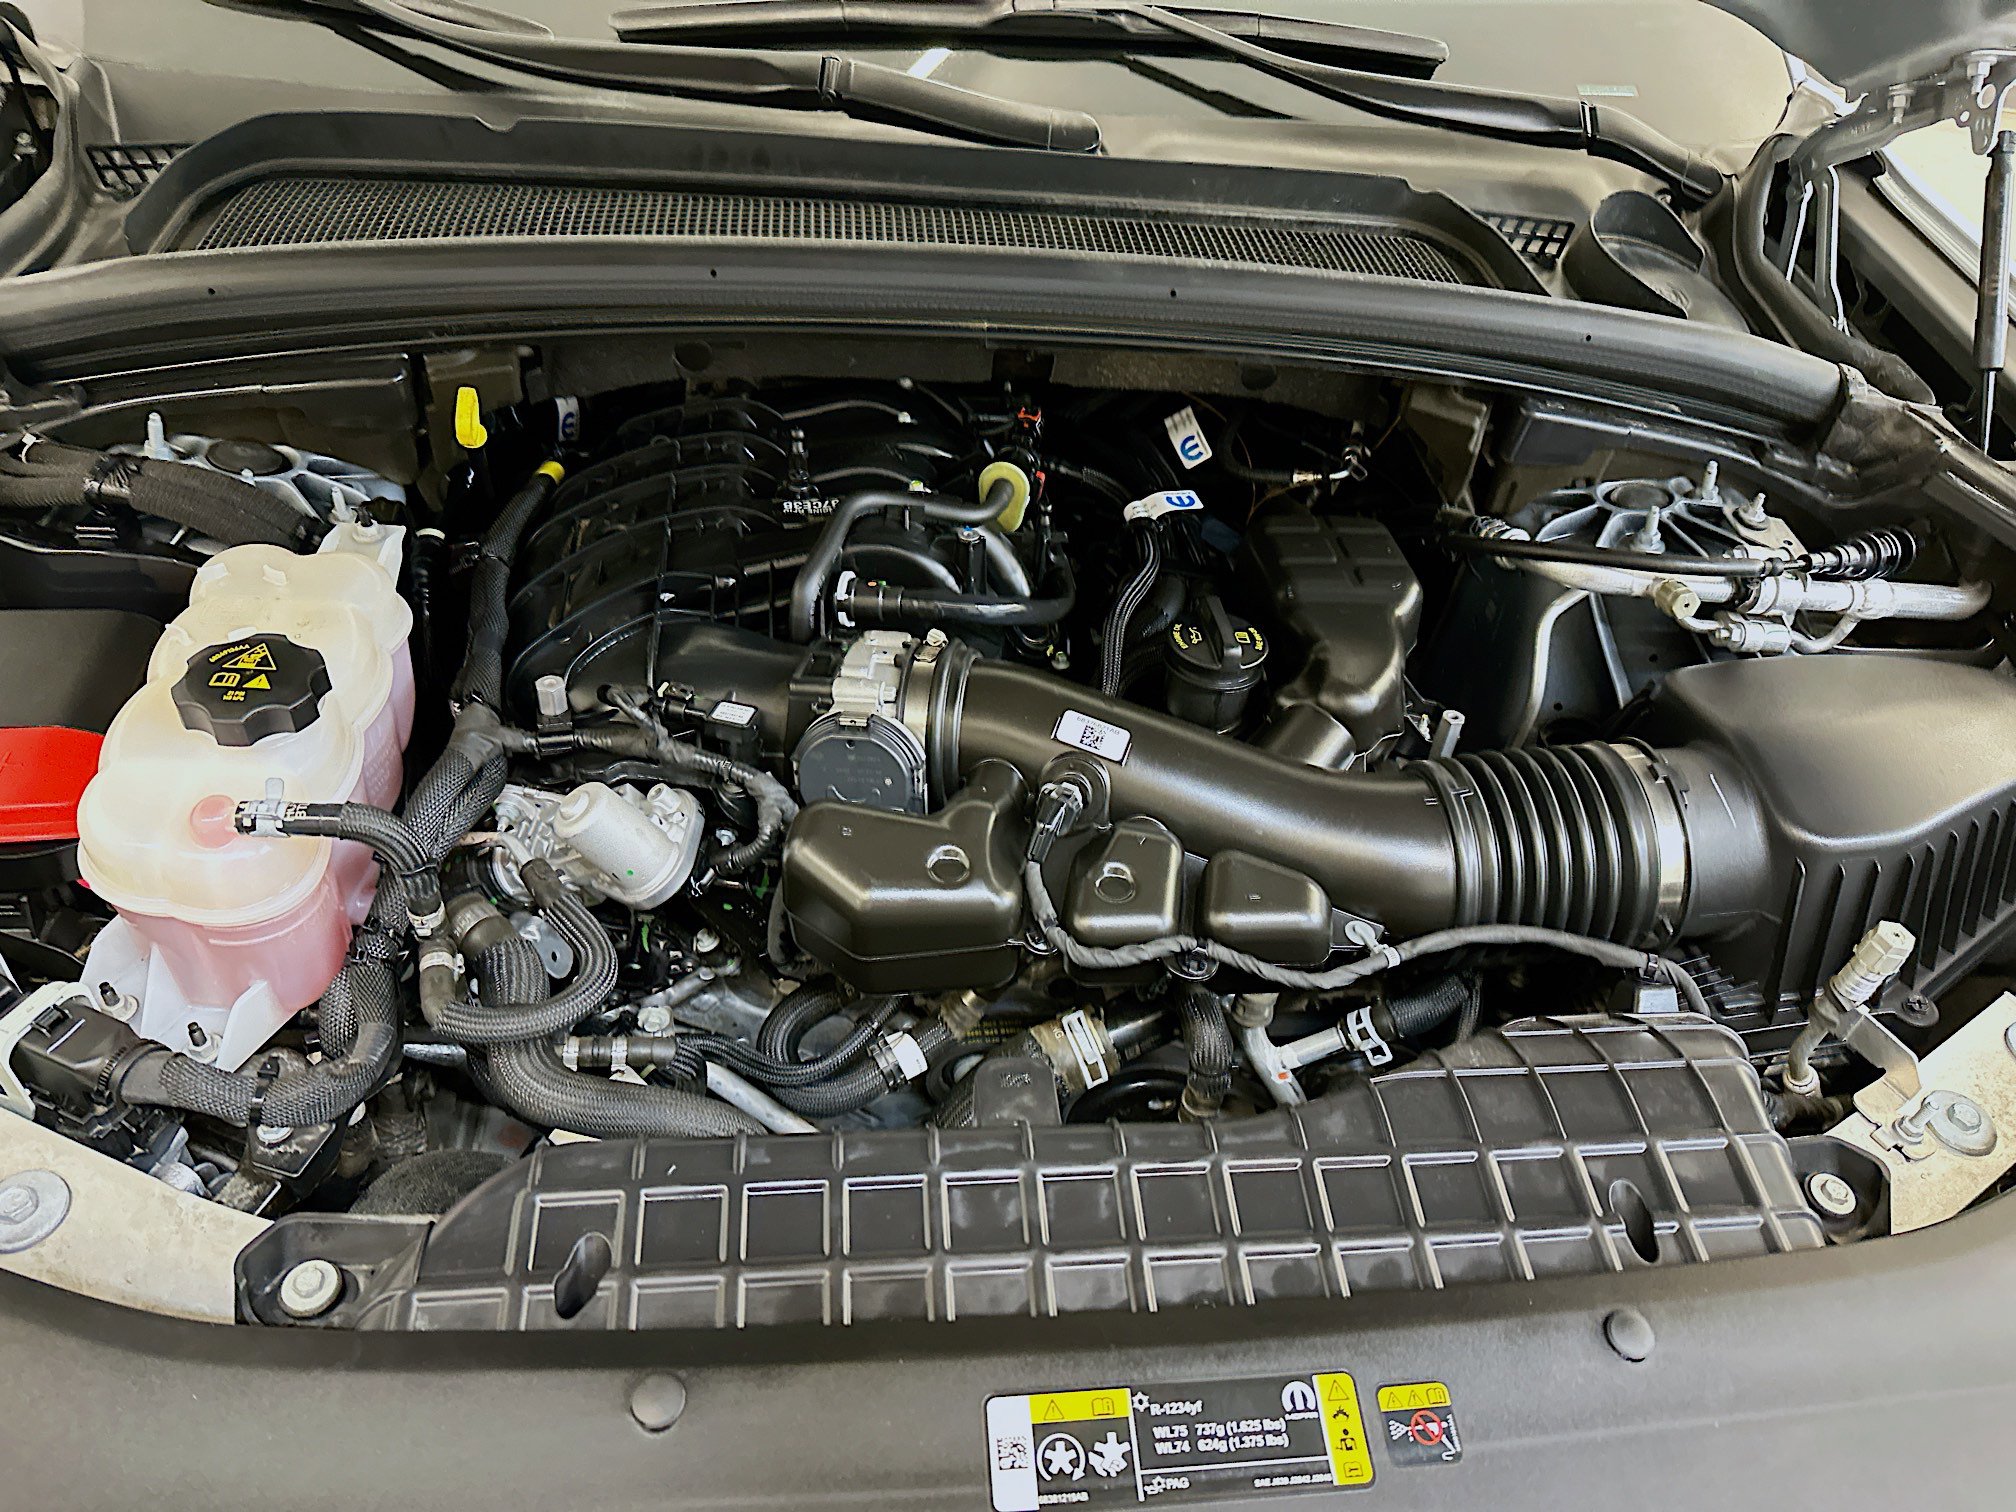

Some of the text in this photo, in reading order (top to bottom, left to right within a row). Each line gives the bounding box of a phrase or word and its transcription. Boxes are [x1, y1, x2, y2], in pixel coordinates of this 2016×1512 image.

[1152, 1425, 1189, 1439] WL75
[1194, 1422, 1225, 1438] 737g
[1154, 1439, 1191, 1455] WL74
[1165, 1476, 1191, 1490] PAG
